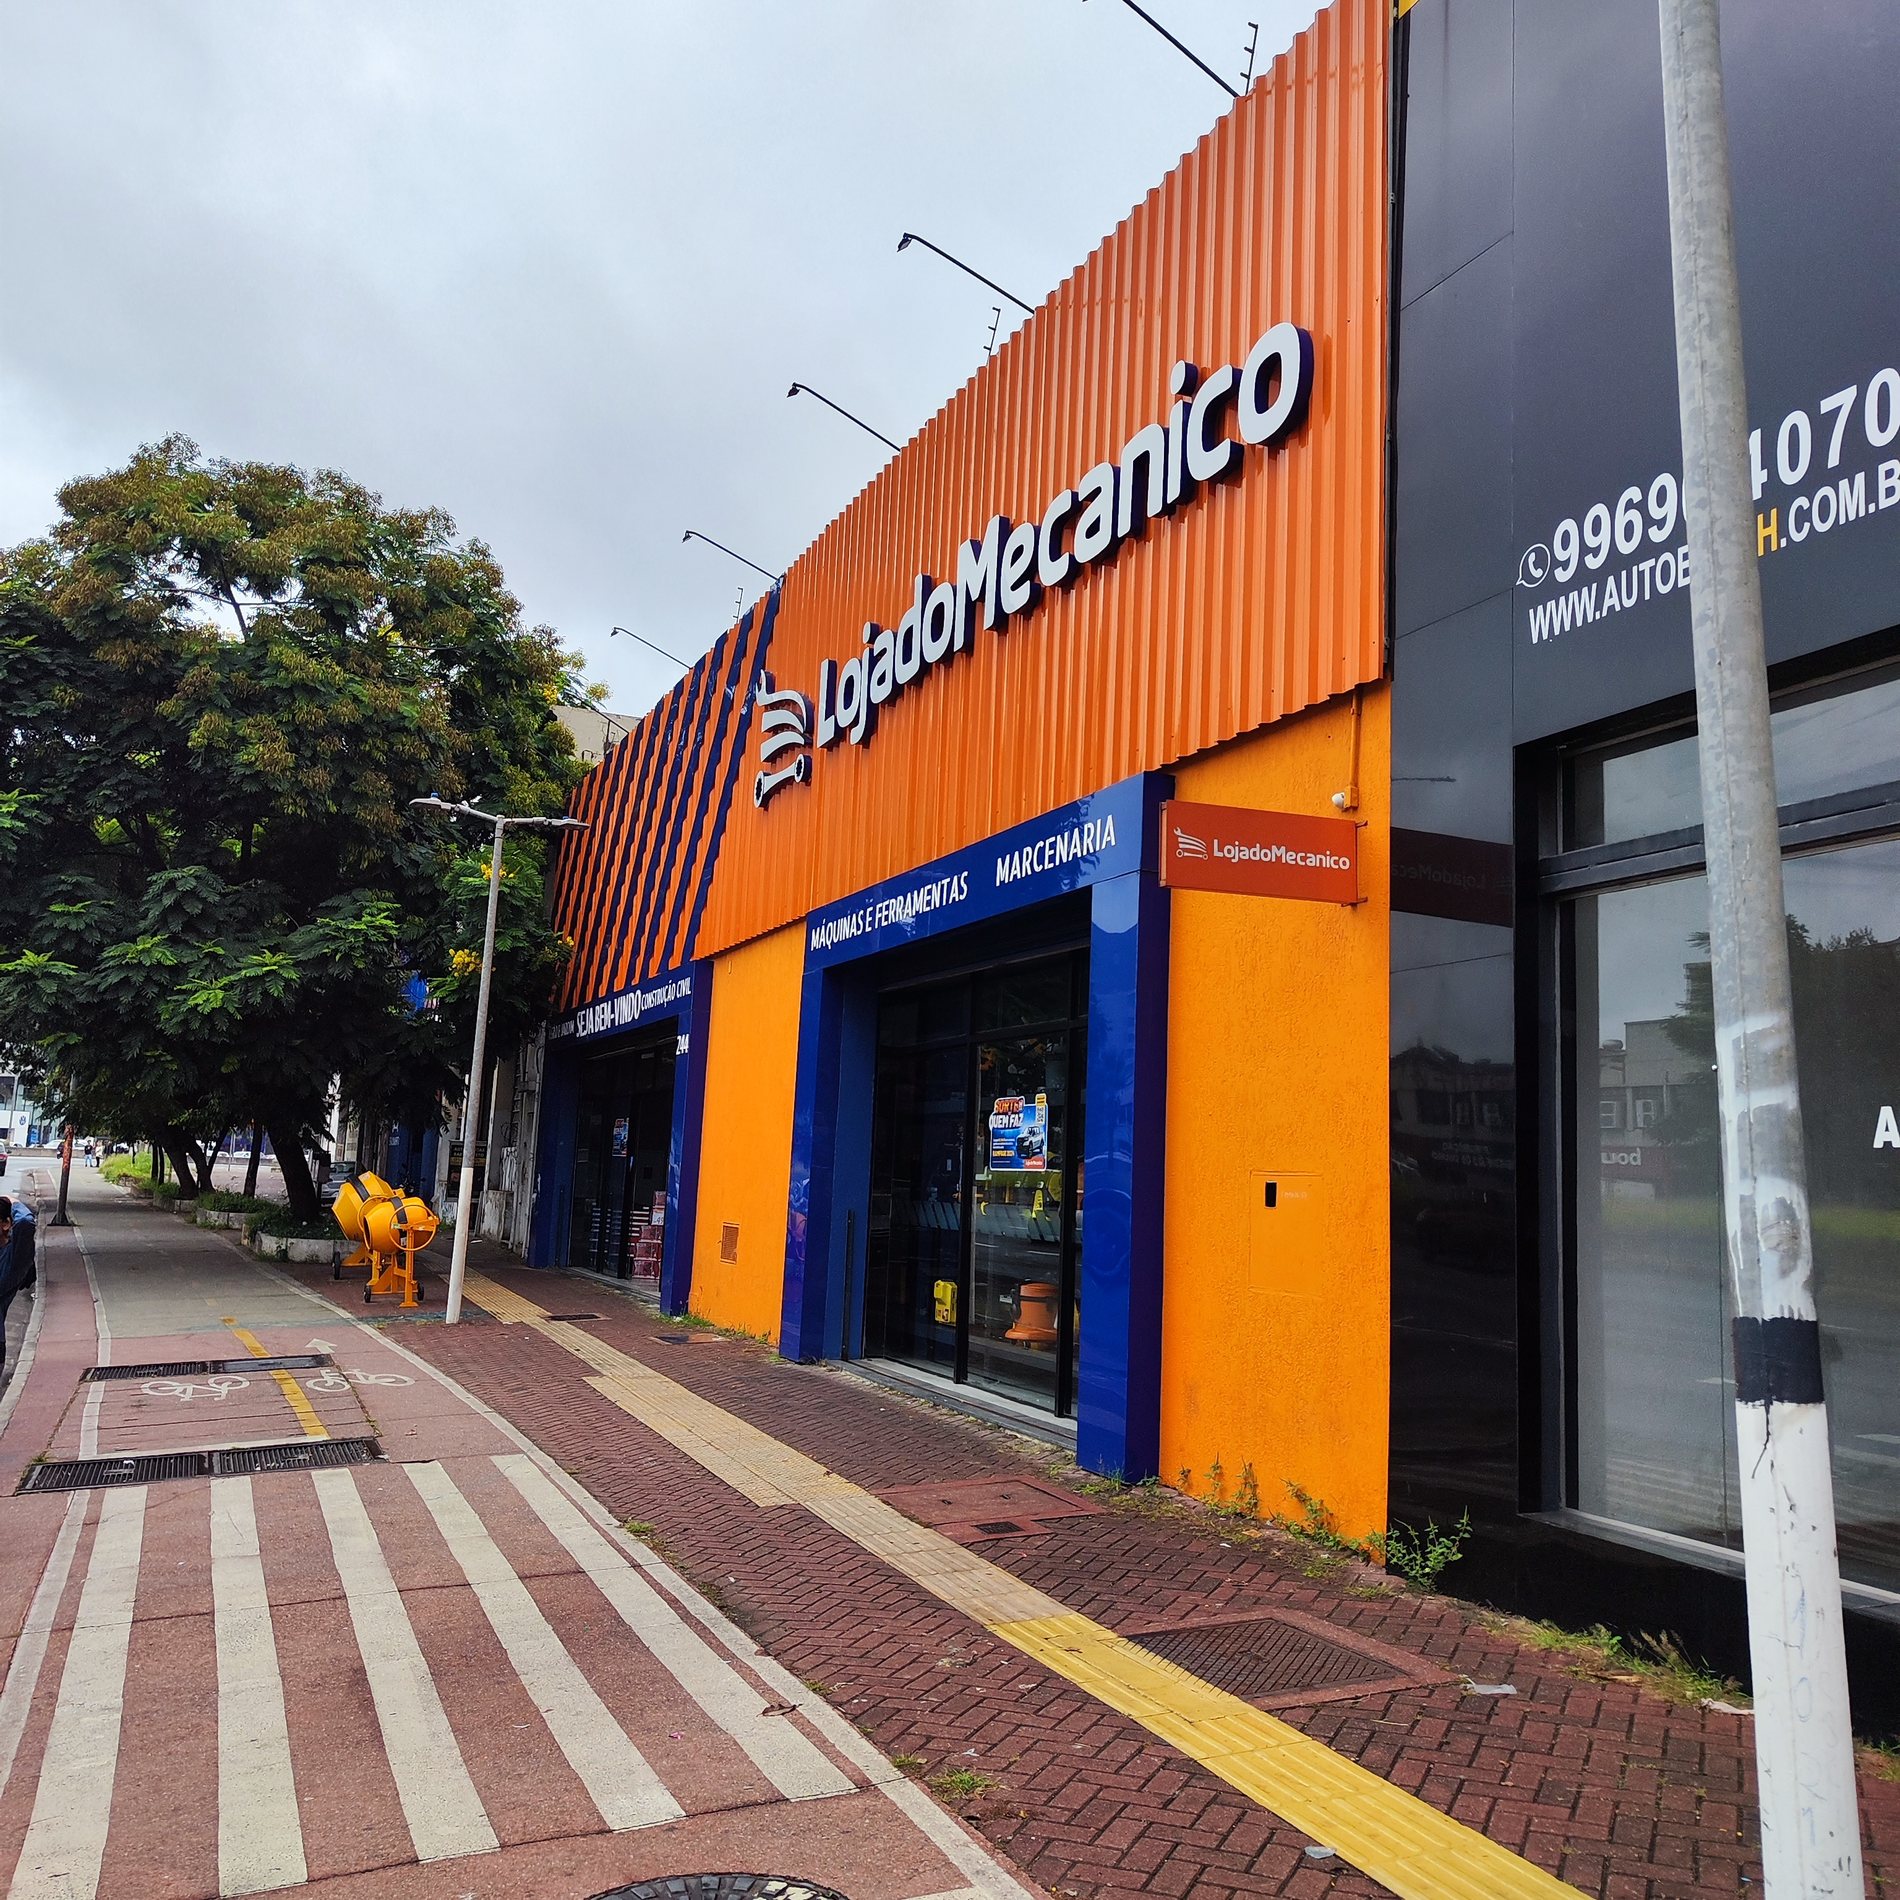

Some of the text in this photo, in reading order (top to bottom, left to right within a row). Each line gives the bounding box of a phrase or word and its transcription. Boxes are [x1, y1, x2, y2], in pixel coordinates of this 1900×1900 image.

[816, 321, 1308, 750] LojadoMecanico
[995, 814, 1116, 887] MARCENARIA
[1212, 838, 1350, 870] LojadoMecanico
[810, 909, 863, 951] MÁQUINAS
[874, 871, 969, 929] FERRAMENTAS
[576, 1009, 594, 1037] SEJA
[594, 989, 642, 1033] BEM-VINDO
[641, 976, 692, 1011] CONSTRUÇÃO CIVIL
[675, 1033, 689, 1055] 244
[989, 1113, 1024, 1129] QUEM FAZ
